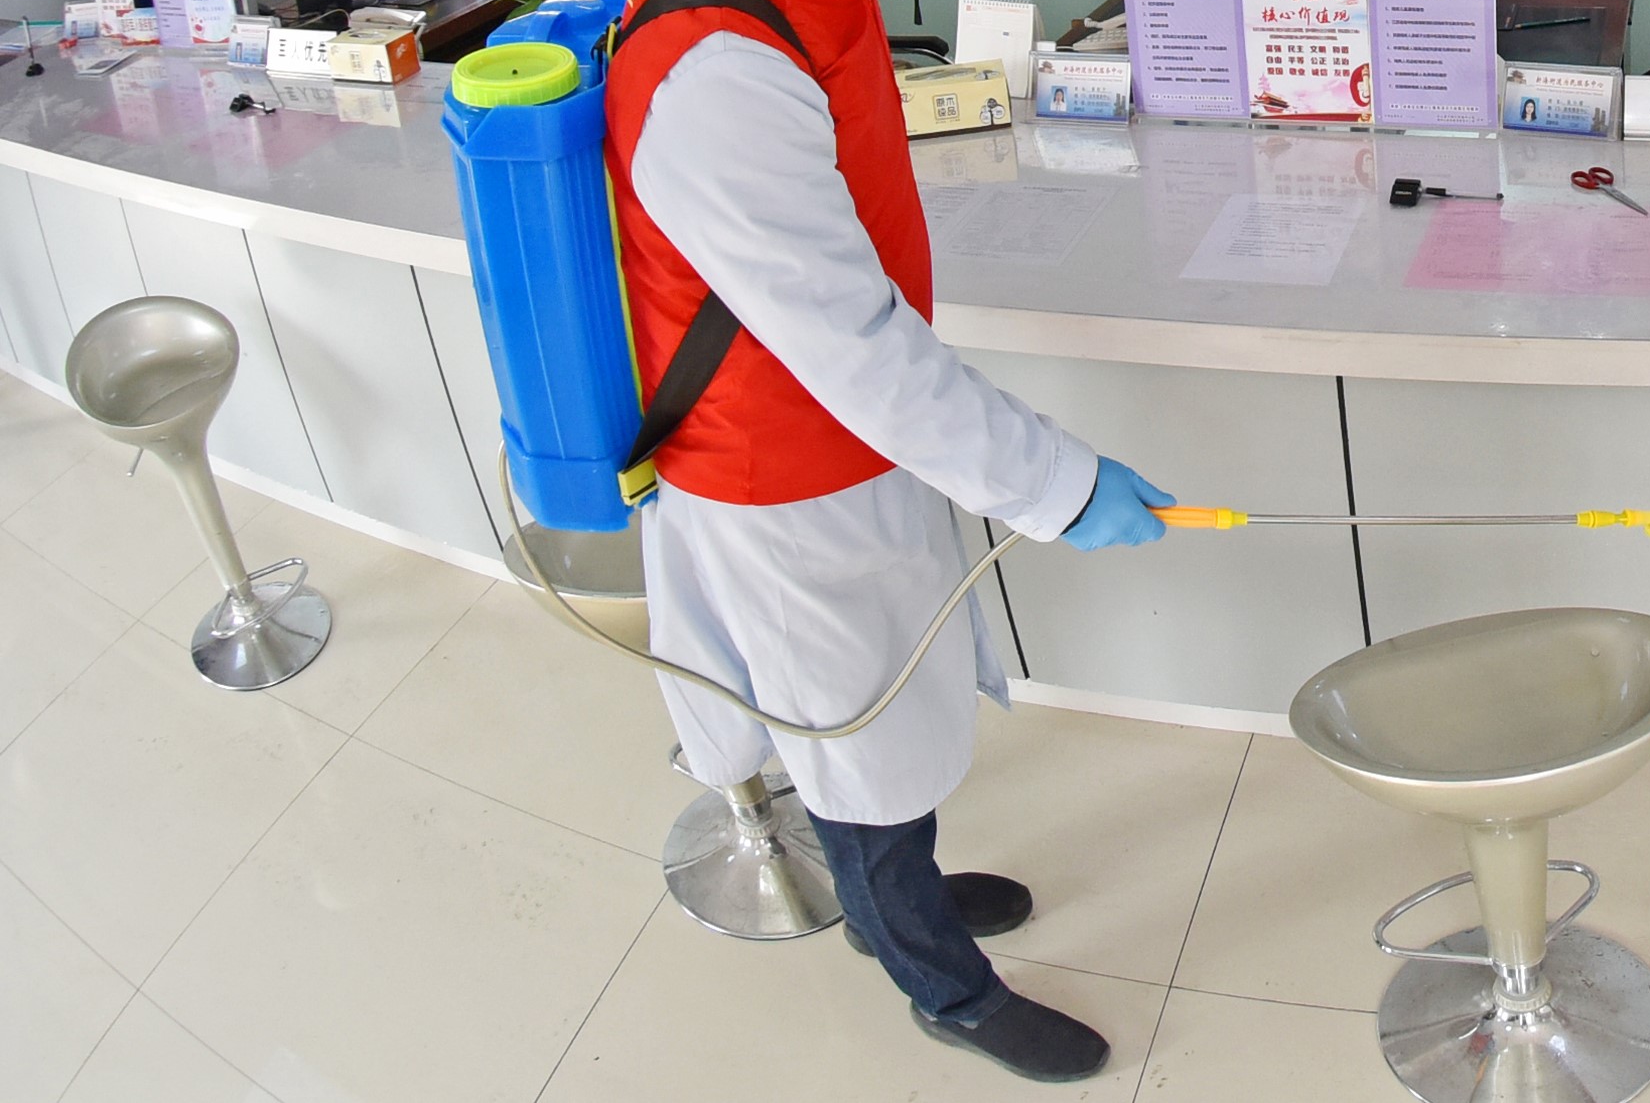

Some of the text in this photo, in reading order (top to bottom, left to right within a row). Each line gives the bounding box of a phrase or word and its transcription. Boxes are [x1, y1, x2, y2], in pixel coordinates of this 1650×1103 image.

[1288, 45, 1304, 53] 民主
[1310, 45, 1327, 53] 文明
[1265, 56, 1282, 64] 自由
[1288, 56, 1304, 64] 平等
[1311, 57, 1327, 65] 公正
